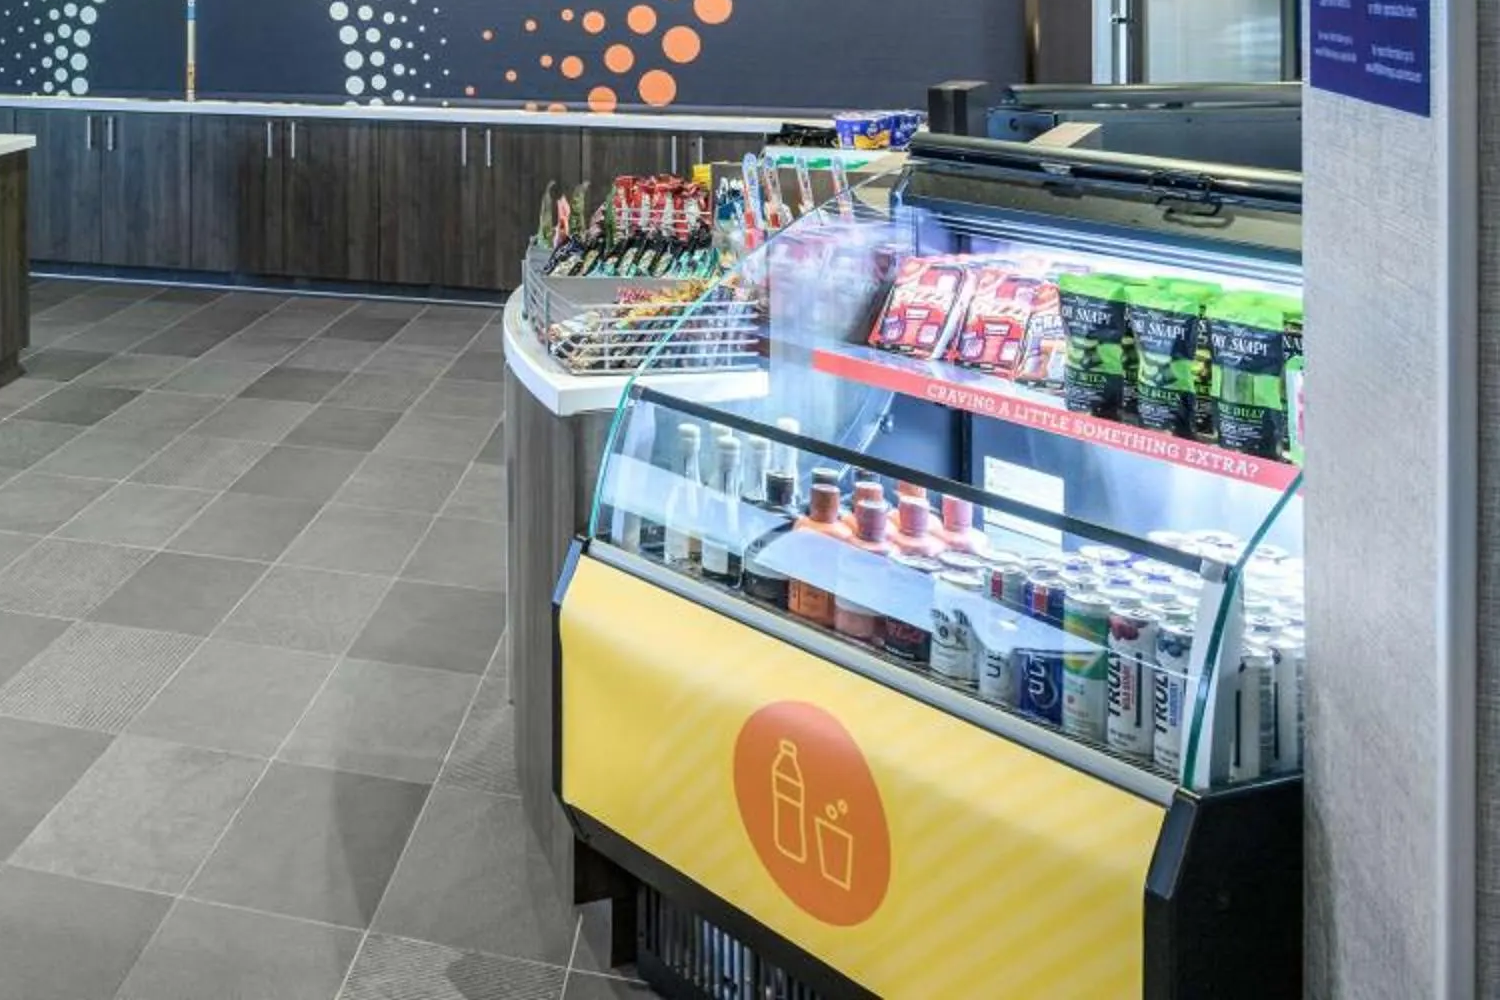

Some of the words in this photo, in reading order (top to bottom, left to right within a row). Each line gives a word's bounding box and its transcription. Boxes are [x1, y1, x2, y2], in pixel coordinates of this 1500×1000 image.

[927, 384, 996, 413] CRAVING
[999, 402, 1010, 417] A
[1014, 404, 1070, 430] LITTLE
[1075, 419, 1180, 458] SOMETHING
[1186, 447, 1259, 477] EXTRA?
